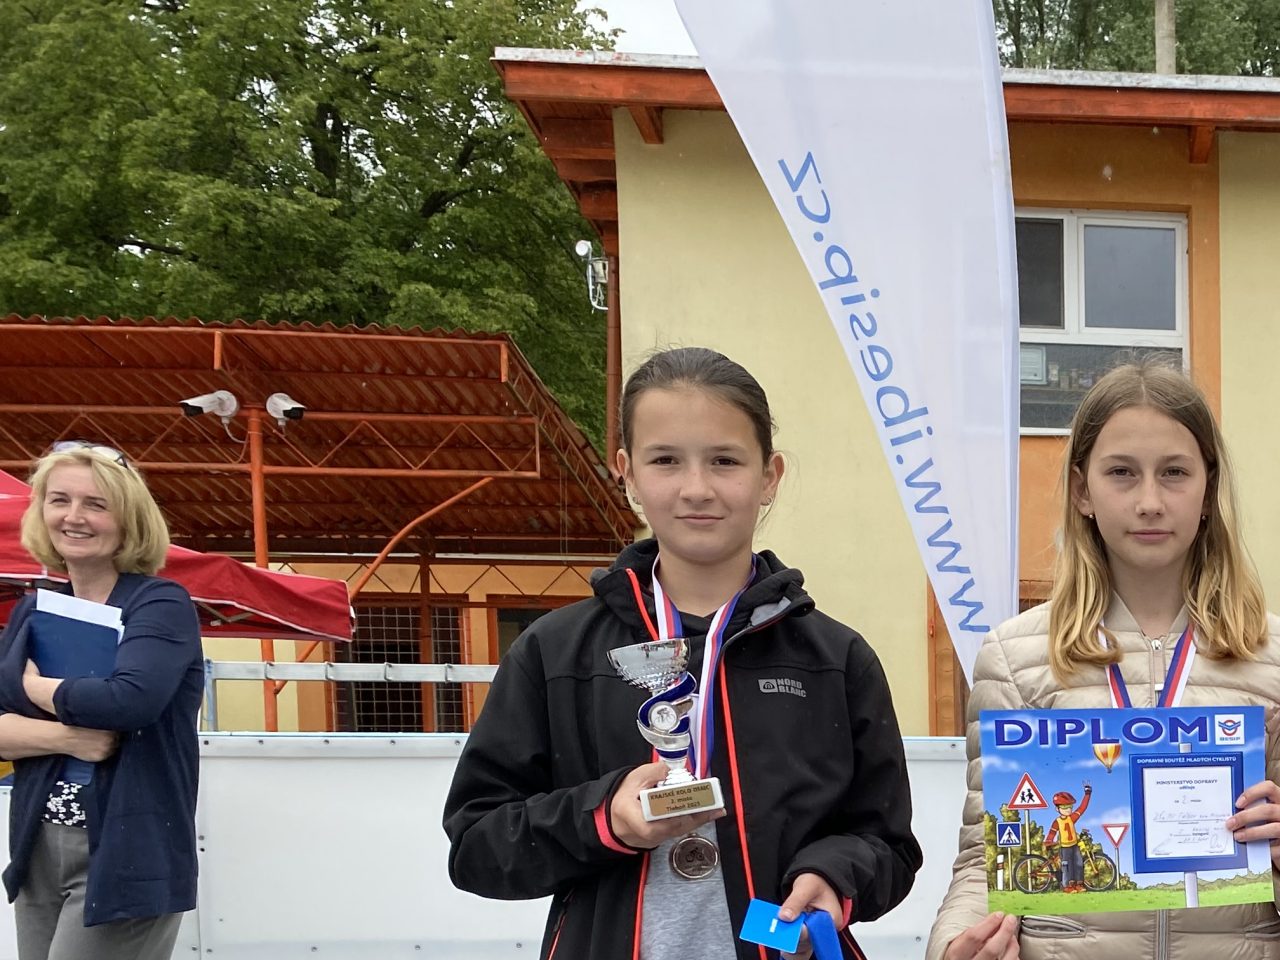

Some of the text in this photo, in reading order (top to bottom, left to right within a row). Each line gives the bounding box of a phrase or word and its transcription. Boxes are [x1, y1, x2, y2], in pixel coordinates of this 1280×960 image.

[777, 678, 802, 689] NORD
[778, 685, 807, 698] BLANC
[994, 716, 1208, 746] DIPLOM
